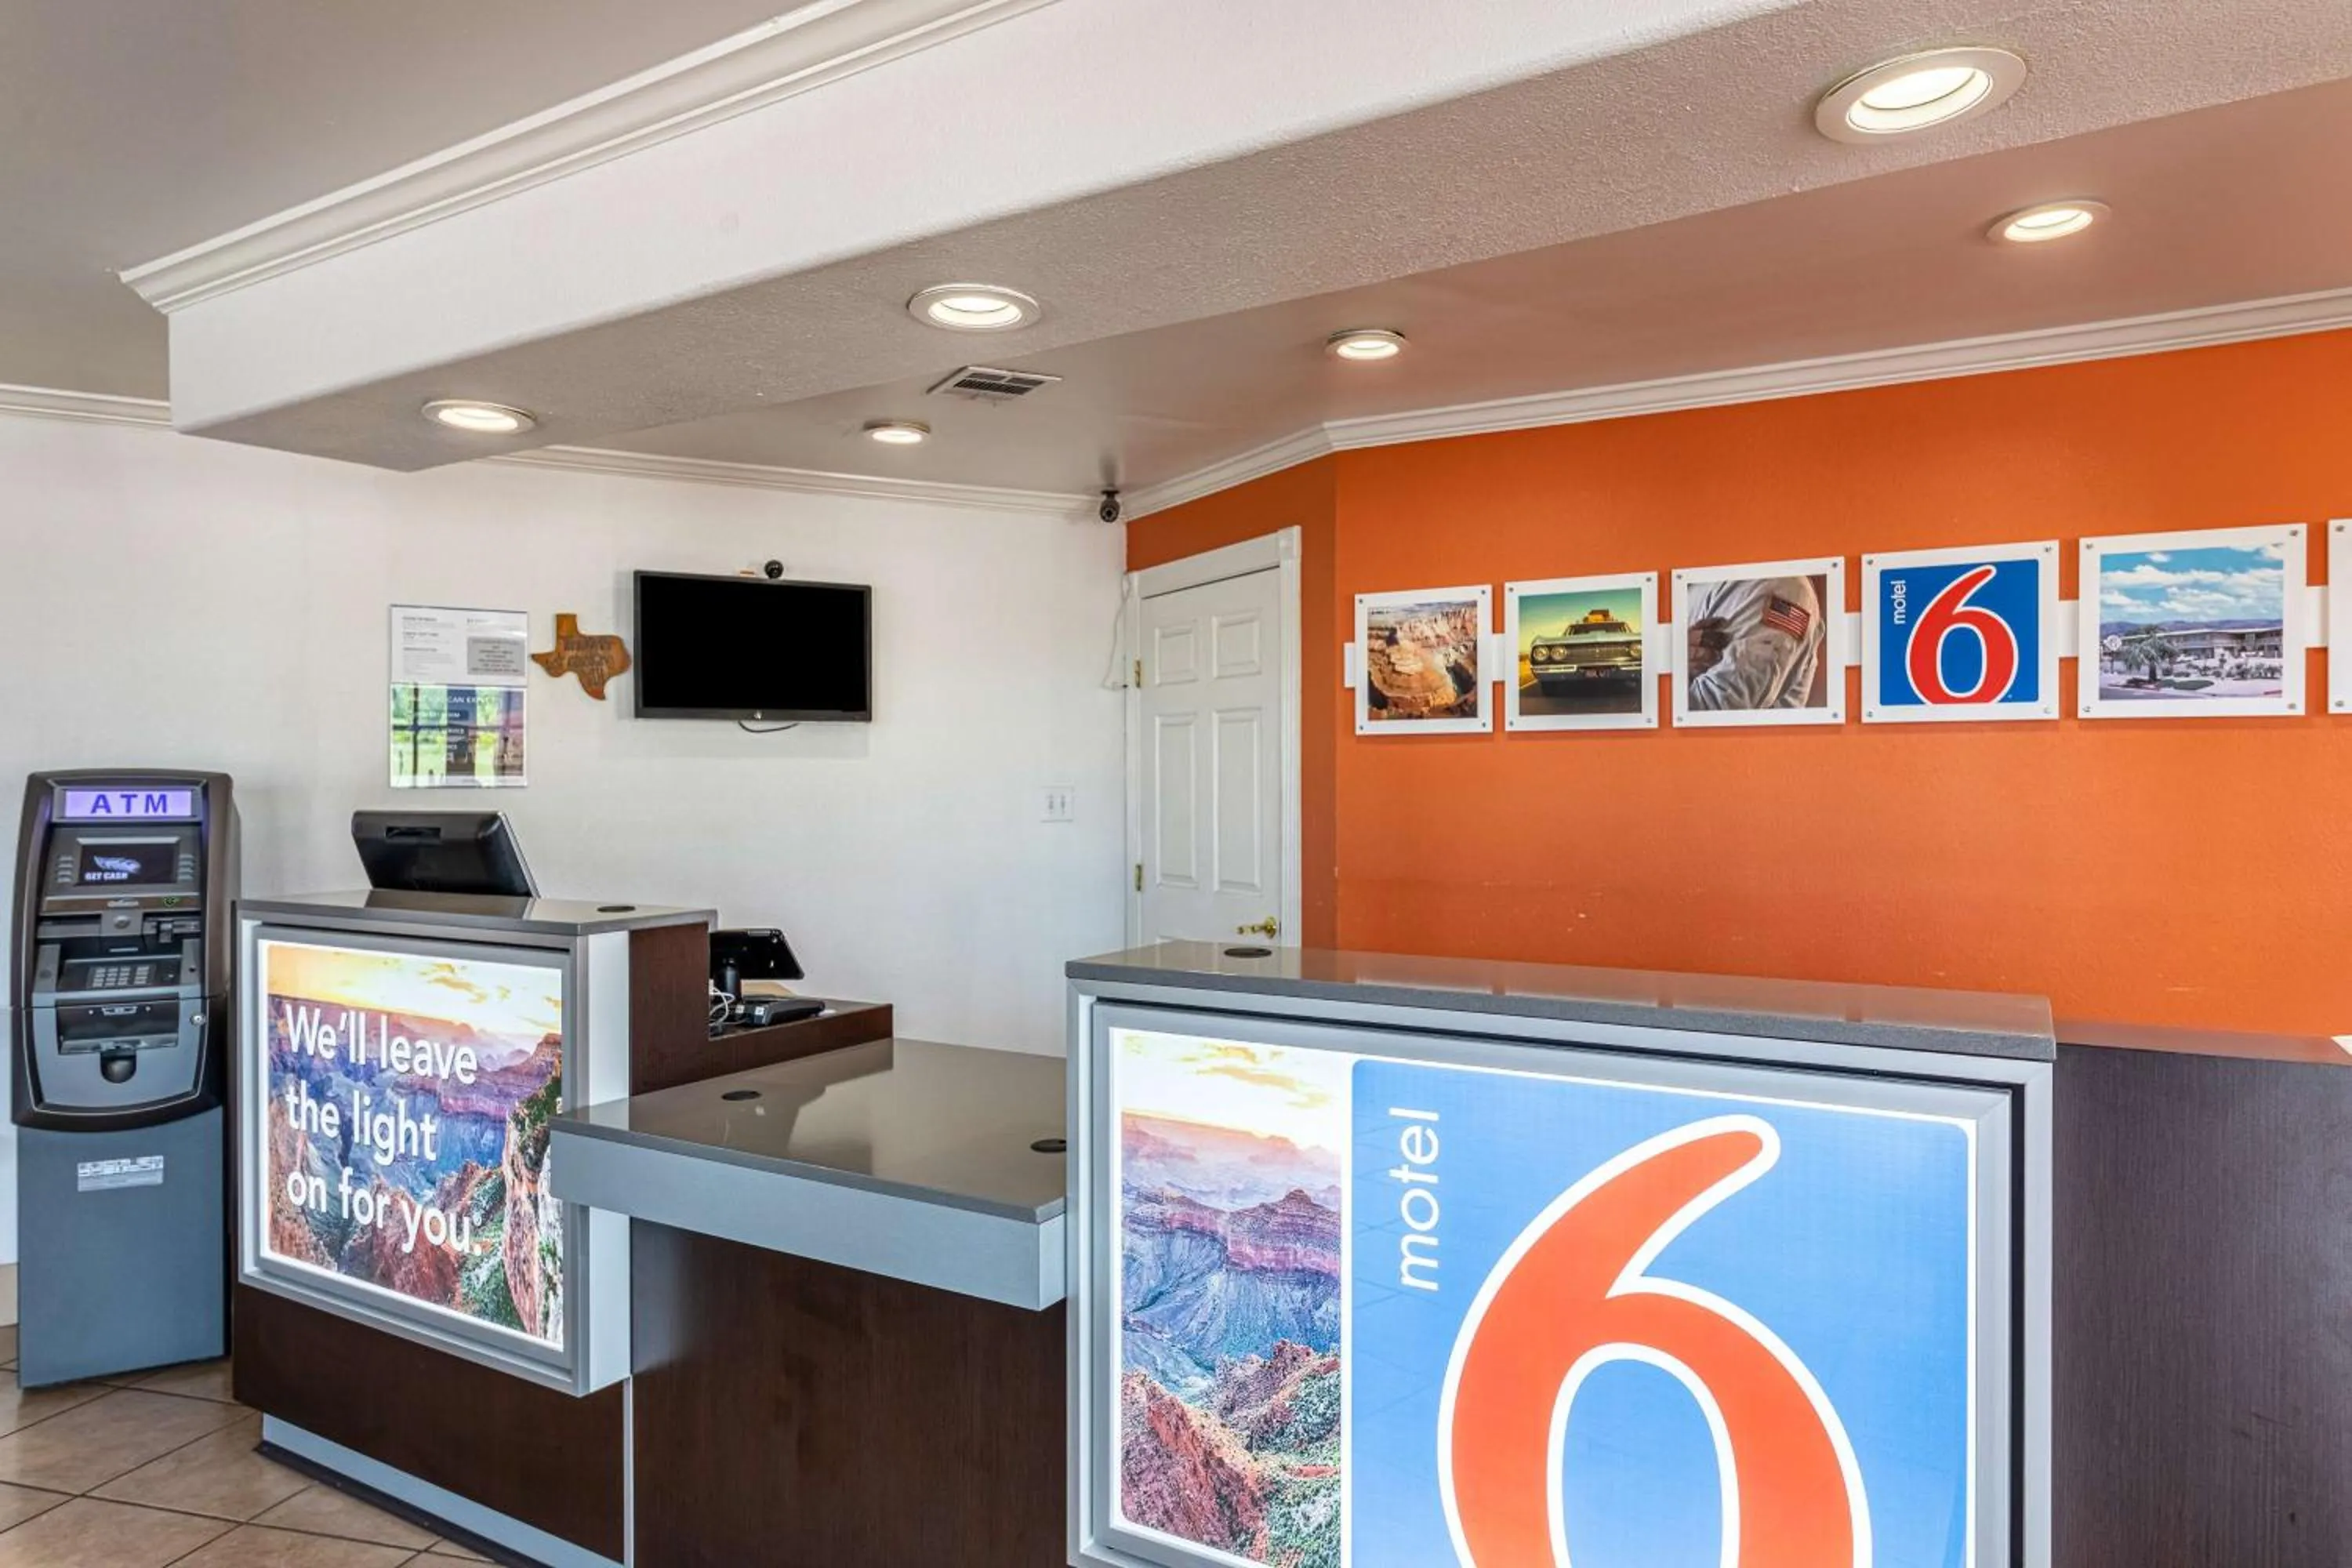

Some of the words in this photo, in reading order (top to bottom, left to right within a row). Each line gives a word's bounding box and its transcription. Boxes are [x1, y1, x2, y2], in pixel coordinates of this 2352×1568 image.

[1890, 579, 1907, 625] motel
[1905, 564, 2020, 705] 6
[90, 793, 168, 814] ATM
[85, 872, 102, 880] GET
[103, 871, 128, 880] CASH
[285, 1004, 366, 1065] We'll
[379, 1014, 478, 1084] leave
[285, 1080, 340, 1138] the
[354, 1090, 437, 1166] light
[287, 1171, 327, 1213] on
[338, 1167, 391, 1229] for
[1388, 1107, 1439, 1291] motel
[1438, 1114, 1873, 1568] 6
